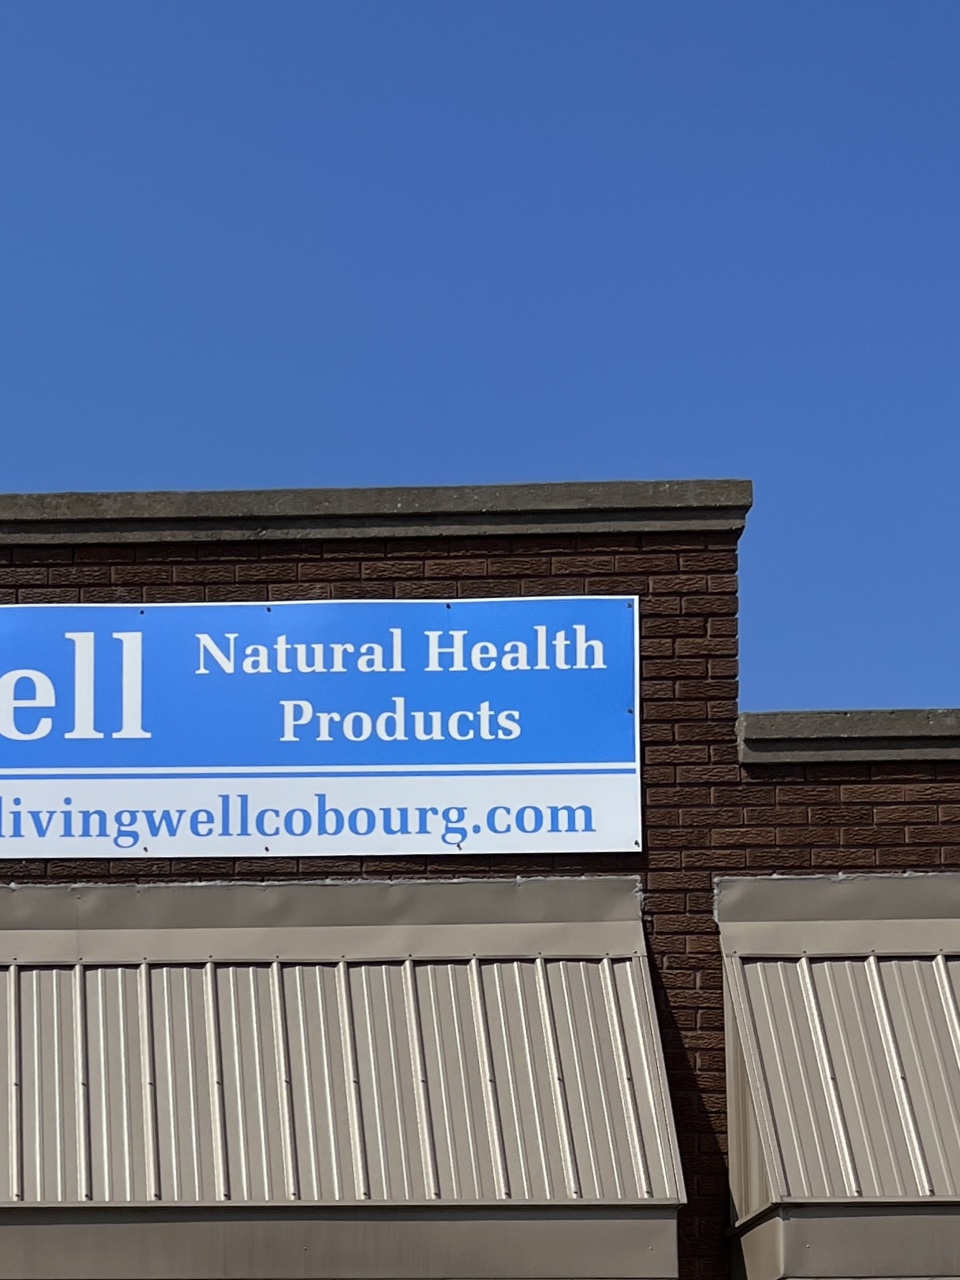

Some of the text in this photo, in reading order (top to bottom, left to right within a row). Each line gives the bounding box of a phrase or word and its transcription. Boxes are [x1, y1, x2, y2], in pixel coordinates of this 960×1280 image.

[195, 624, 608, 674] Natural Health
[279, 697, 521, 742] Products
